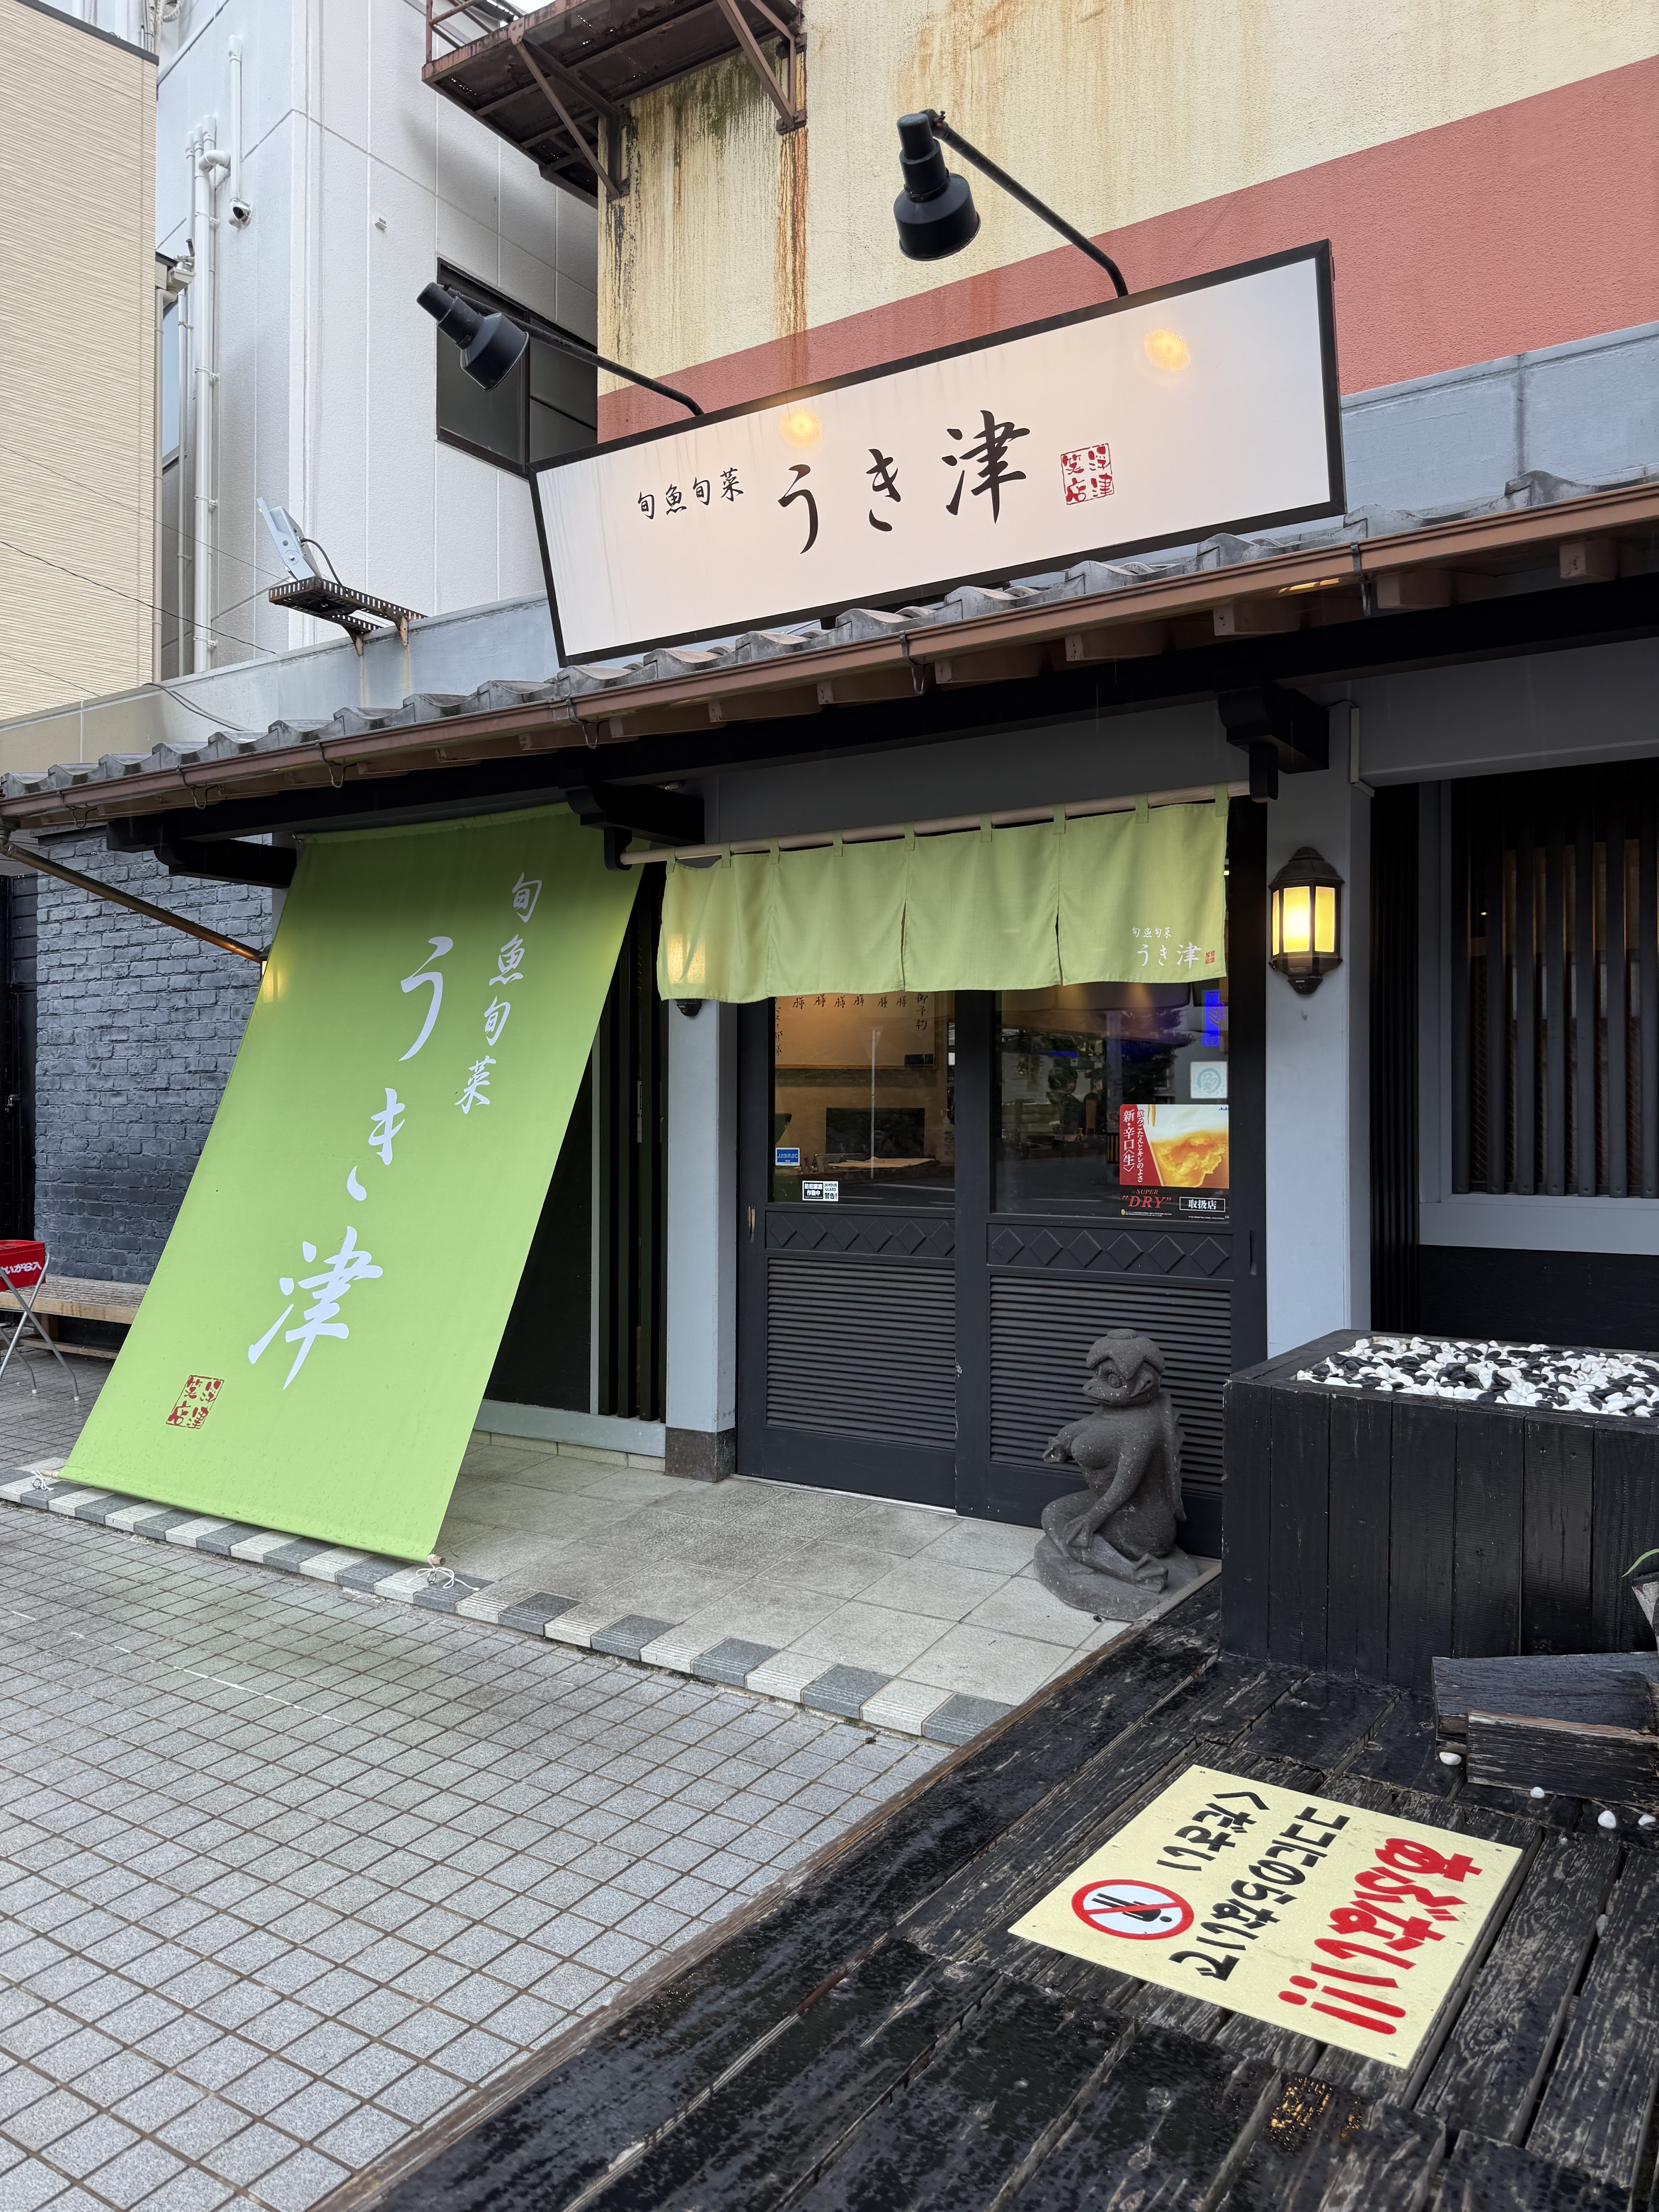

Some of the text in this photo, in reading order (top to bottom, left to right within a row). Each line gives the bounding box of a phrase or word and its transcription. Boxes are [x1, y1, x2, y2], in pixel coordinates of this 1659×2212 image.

[637, 467, 744, 520] 旬魚旬菜
[777, 410, 1030, 554] うき津
[1132, 927, 1171, 938] 旬魚旬菜
[1137, 941, 1201, 969] うき津
[456, 872, 542, 1114] 旬魚旬菜
[247, 936, 454, 1390] うき津
[1188, 1199, 1217, 1210] 取扱店
[0, 1261, 42, 1275] いがら入
[1156, 1791, 1270, 1872] ください
[1168, 1806, 1350, 1982] ココにのらないで
